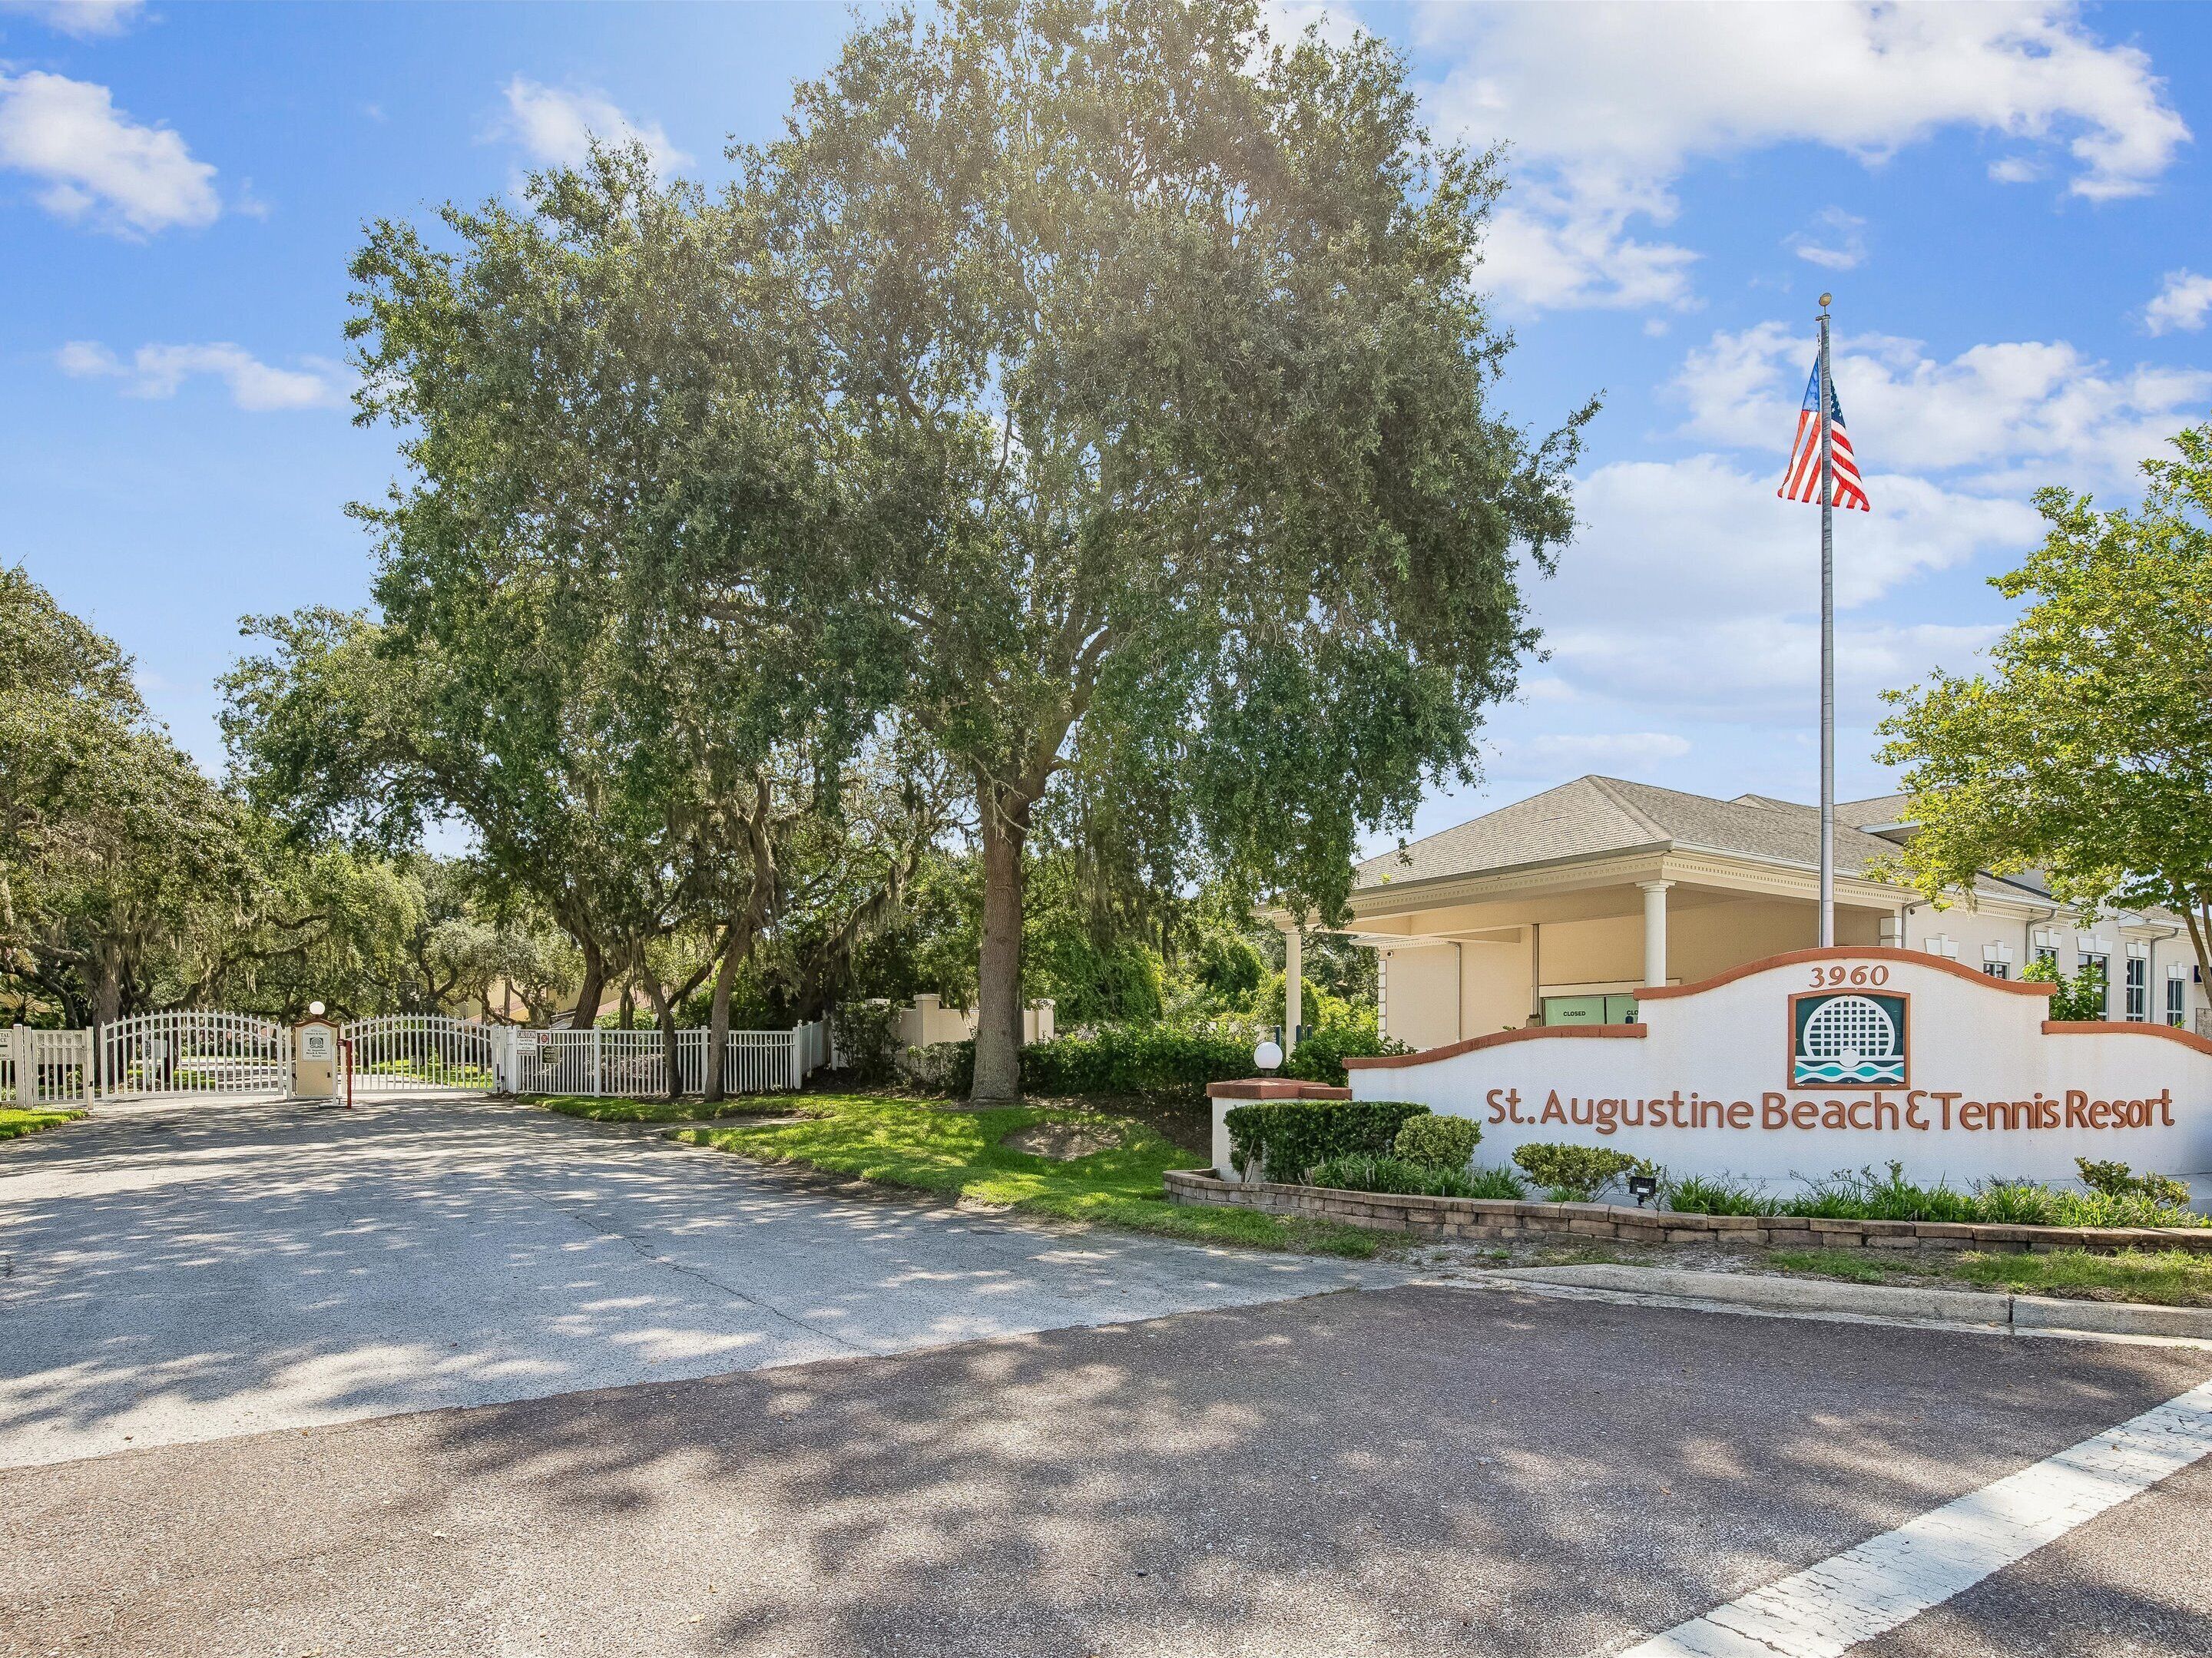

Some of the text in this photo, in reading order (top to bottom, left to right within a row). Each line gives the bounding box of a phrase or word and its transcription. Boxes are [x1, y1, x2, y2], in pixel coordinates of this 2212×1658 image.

[1809, 965, 1889, 988] 3960
[1486, 1088, 1536, 1125] St.
[1540, 1089, 1754, 1135] Augustine
[1762, 1091, 1899, 1131] Beach
[1930, 1092, 2061, 1131] Tennis
[2065, 1088, 2175, 1130] Resort
